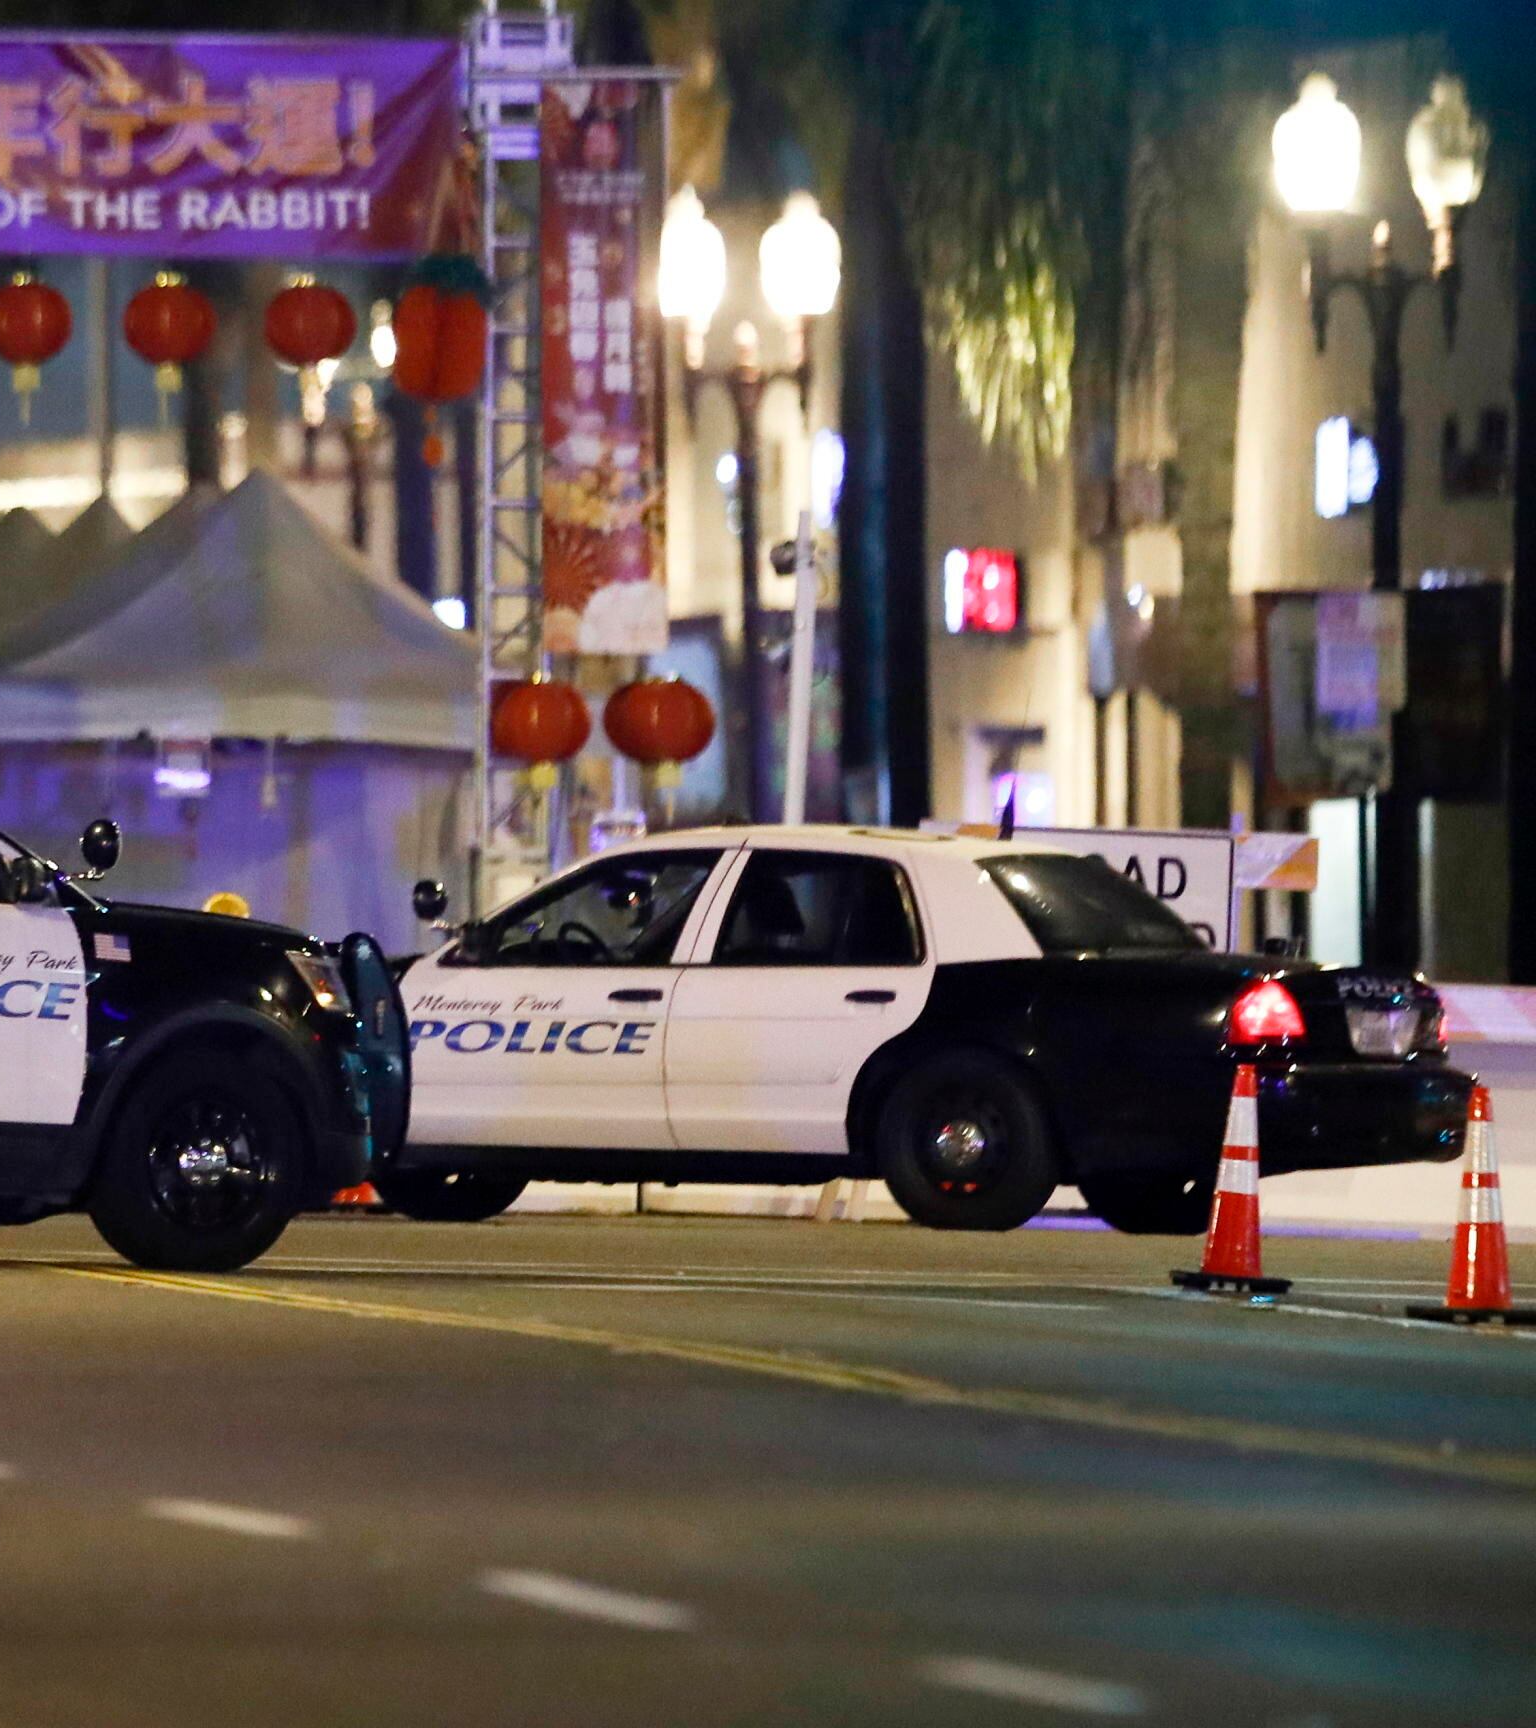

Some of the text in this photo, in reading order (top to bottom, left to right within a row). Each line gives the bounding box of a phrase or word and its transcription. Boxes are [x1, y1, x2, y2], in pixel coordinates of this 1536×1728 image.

[65, 188, 161, 231] THE
[180, 188, 371, 231] RABBIT!
[26, 949, 78, 971] Park
[412, 992, 564, 1016] Monterey Park
[410, 1019, 656, 1055] POLICE
